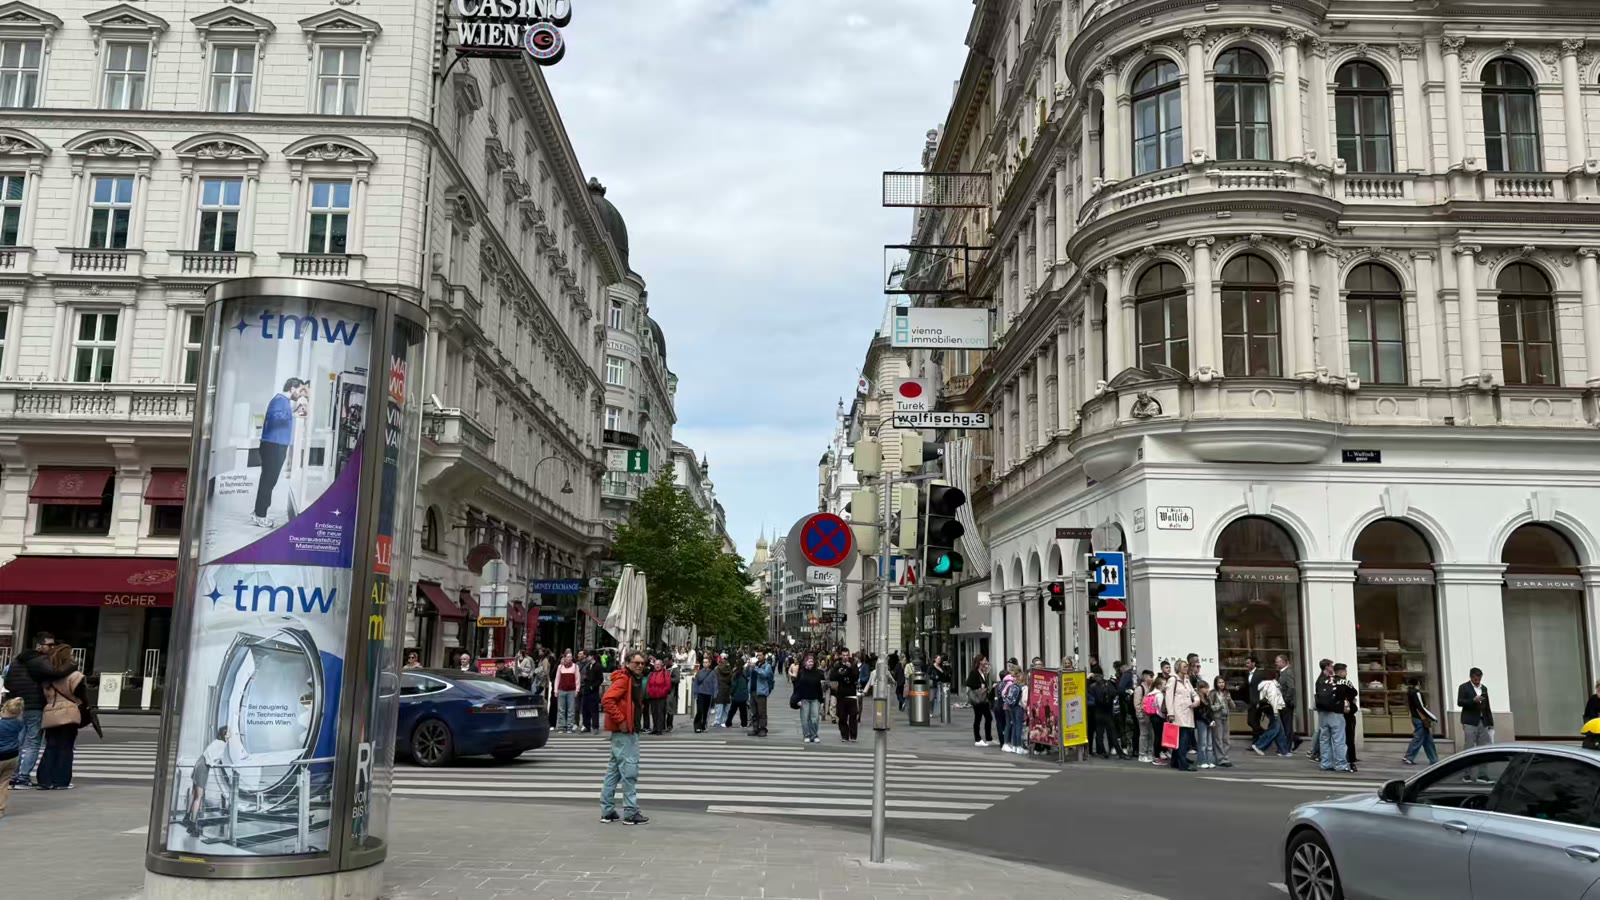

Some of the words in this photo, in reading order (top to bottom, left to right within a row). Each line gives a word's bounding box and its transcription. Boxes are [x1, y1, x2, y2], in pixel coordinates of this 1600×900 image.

[457, 0, 570, 19] CASINO
[456, 22, 520, 46] WIEN
[260, 309, 360, 346] tmw
[912, 326, 942, 334] vienna
[912, 336, 984, 344] immobilien.com
[896, 401, 924, 410] Turek
[898, 414, 985, 426] walfischg.3
[104, 594, 156, 606] SACHER
[233, 580, 336, 613] tmw
